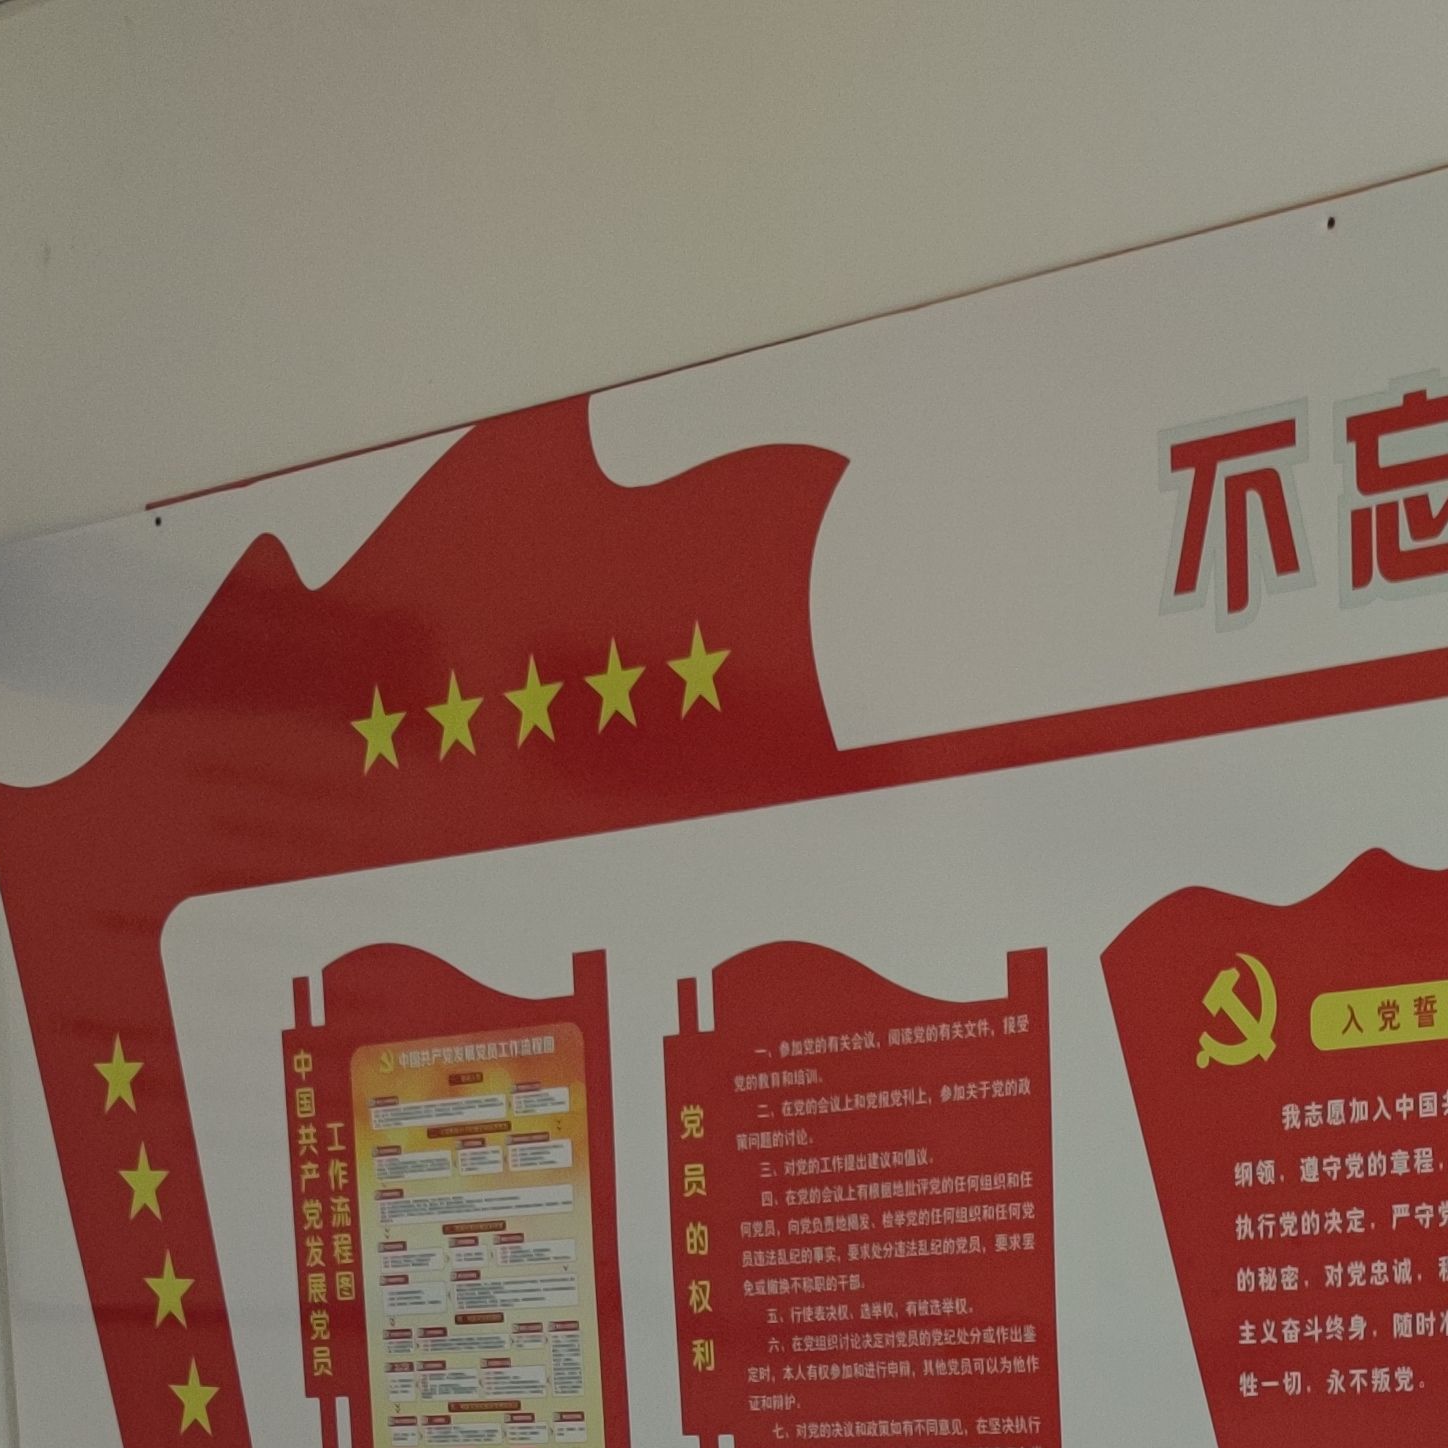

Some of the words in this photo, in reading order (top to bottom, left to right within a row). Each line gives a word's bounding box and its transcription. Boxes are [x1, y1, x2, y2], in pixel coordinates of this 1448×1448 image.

[293, 1049, 332, 1377] 中国共产党发展党员
[327, 1122, 355, 1301] 工作流程图
[680, 1105, 715, 1373] 党员的权利
